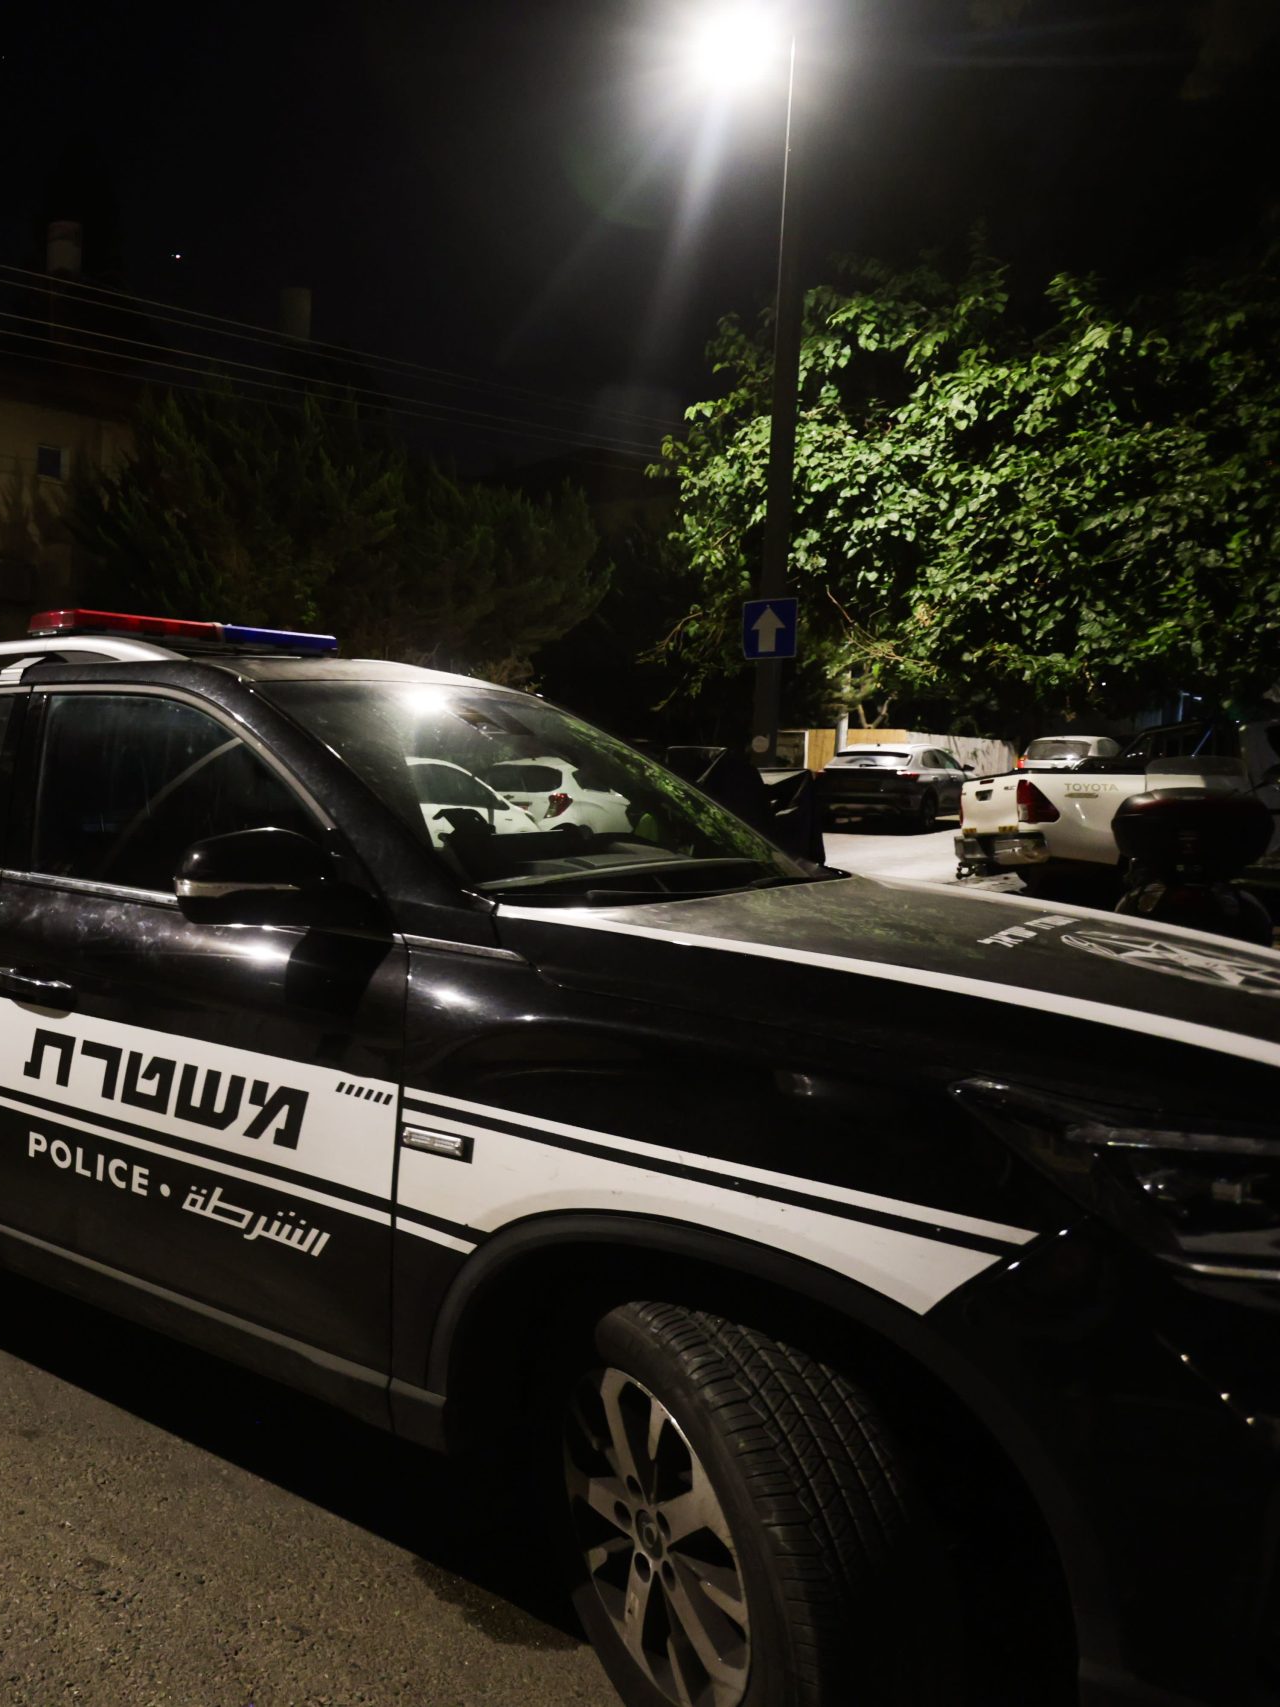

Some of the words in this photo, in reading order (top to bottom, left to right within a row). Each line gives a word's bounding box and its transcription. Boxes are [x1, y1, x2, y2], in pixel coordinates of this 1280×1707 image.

[1064, 783, 1119, 792] TOYOTA
[23, 1028, 310, 1150] משטרת
[28, 1131, 150, 1196] POLICE
[181, 1186, 331, 1257] الشرطة
